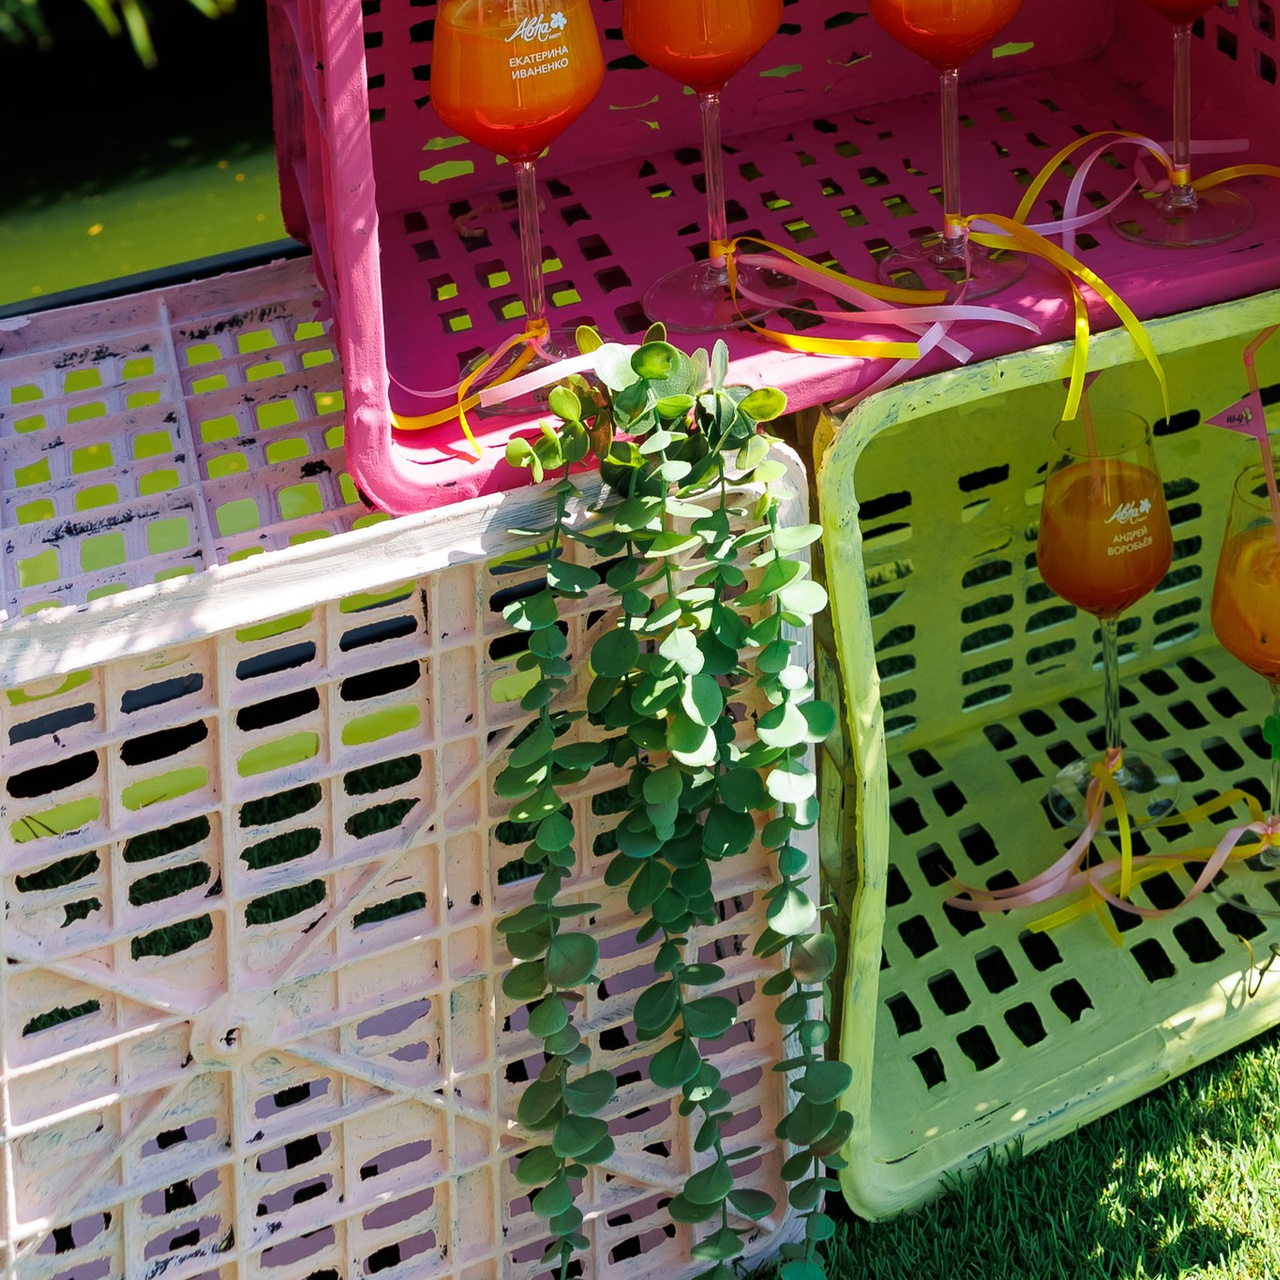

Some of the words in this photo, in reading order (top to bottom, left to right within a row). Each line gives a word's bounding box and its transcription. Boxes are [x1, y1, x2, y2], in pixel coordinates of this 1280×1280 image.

[504, 13, 553, 43] Aloha
[509, 44, 569, 68] ЕКАТЕРИНА
[511, 57, 569, 80] ИВАНЕНКО
